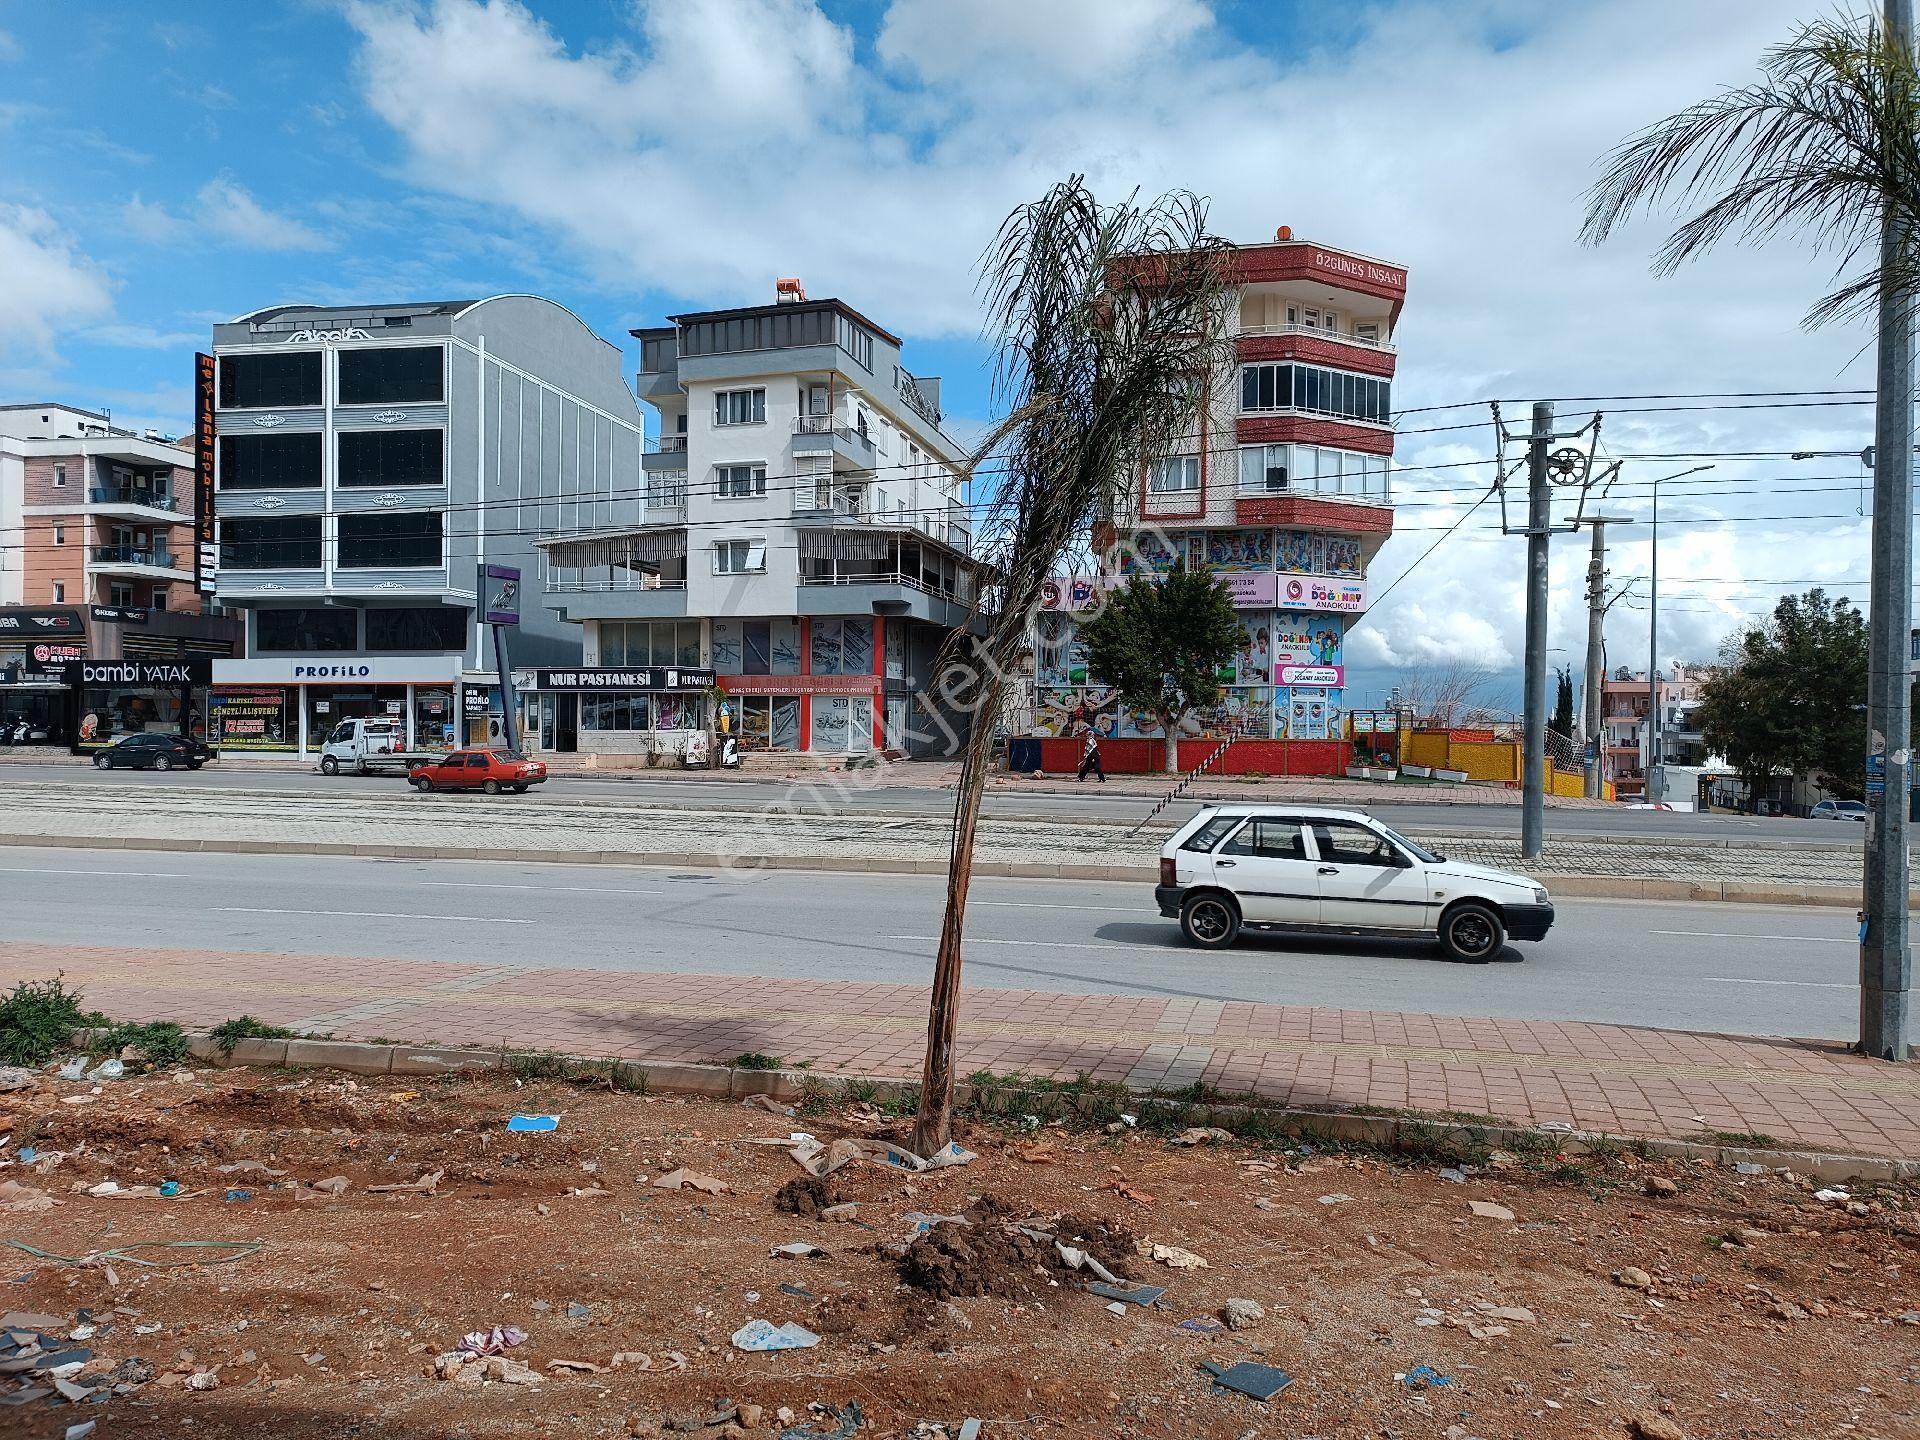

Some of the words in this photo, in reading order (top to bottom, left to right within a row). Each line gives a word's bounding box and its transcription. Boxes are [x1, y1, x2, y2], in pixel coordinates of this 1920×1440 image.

[1316, 252, 1364, 277] ÖZGÜNEŞ
[1367, 265, 1402, 285] İNŞAAT
[1315, 601, 1358, 610] ANAOKULU
[83, 663, 139, 682] bambi
[144, 666, 190, 682] YATAK
[549, 673, 577, 686] NUR
[579, 670, 651, 686] PASTANESİ
[833, 699, 848, 707] STD
